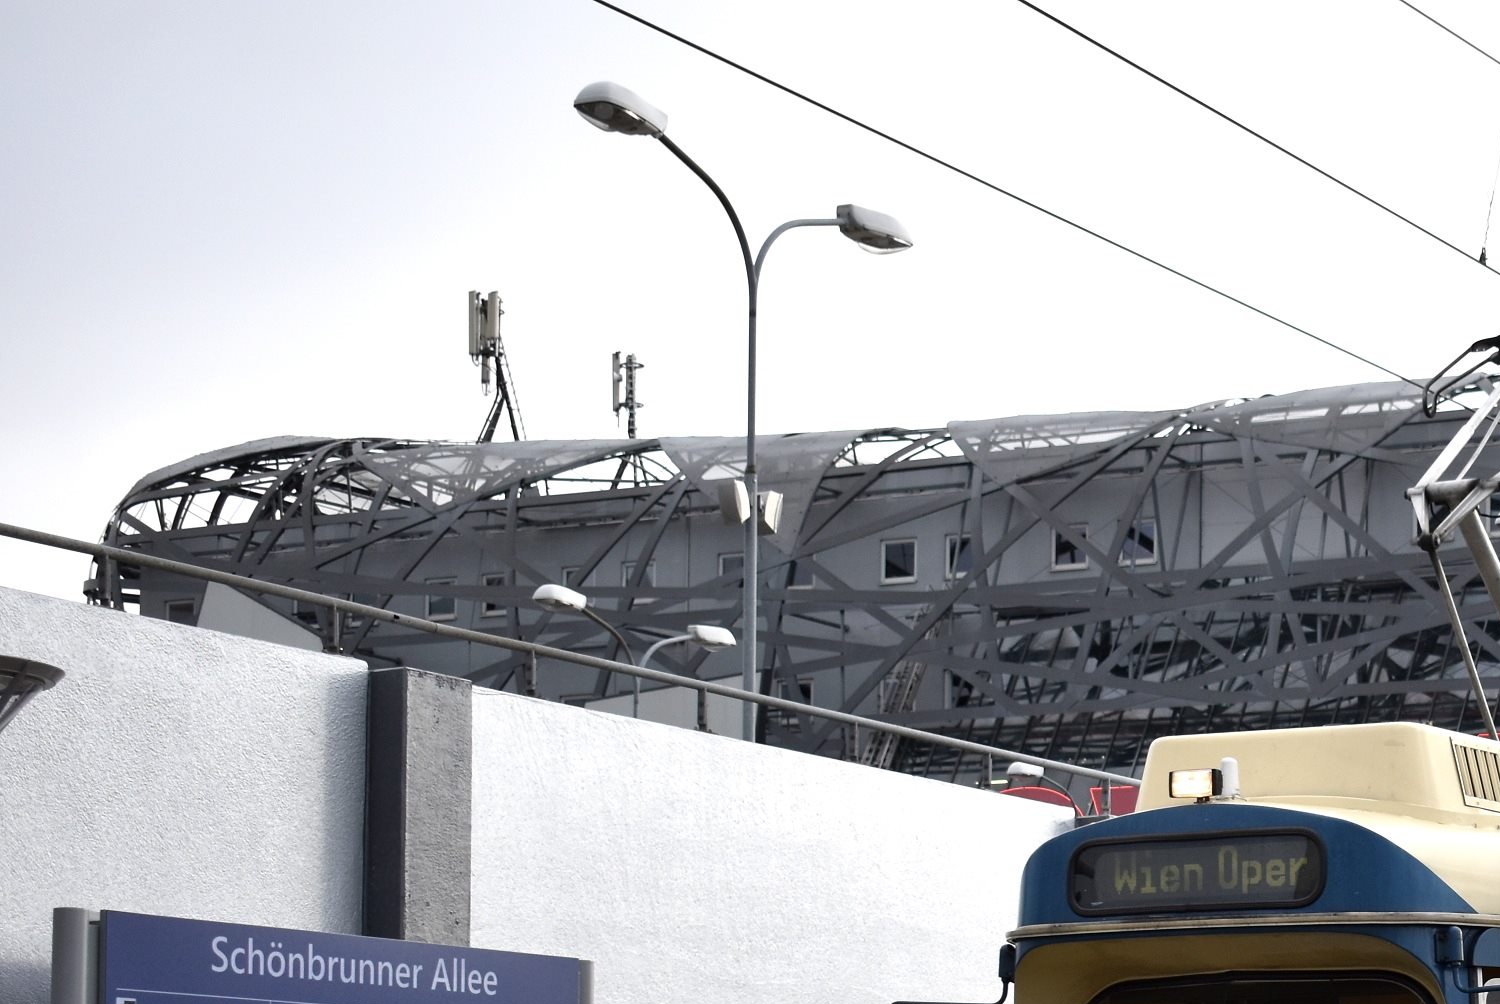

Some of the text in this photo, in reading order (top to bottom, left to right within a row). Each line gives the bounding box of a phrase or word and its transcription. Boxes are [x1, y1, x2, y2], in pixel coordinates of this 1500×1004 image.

[1114, 845, 1309, 895] Wien Oper
[211, 936, 498, 996] Schönbrunner Allee
